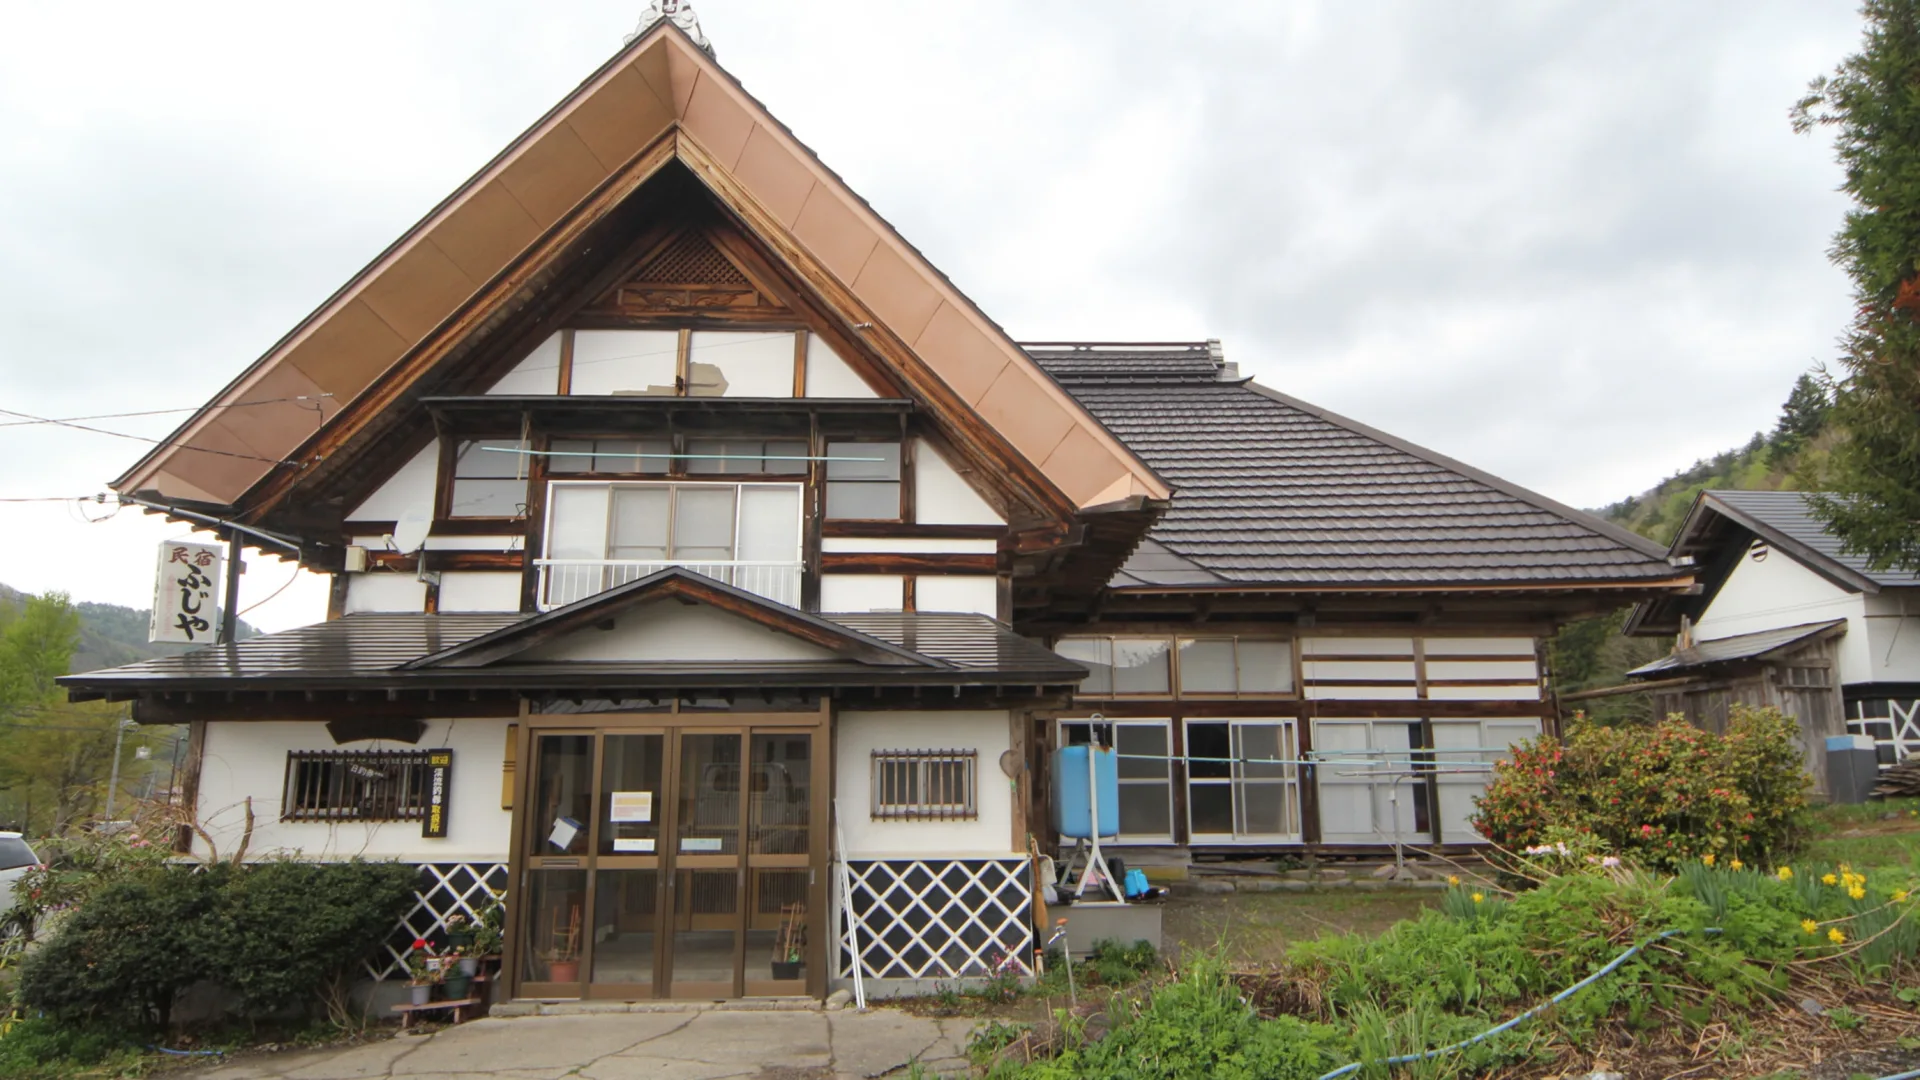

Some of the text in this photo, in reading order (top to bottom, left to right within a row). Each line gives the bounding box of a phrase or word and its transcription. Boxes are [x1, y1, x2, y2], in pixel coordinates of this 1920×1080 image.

[168, 547, 215, 566] 民宿
[173, 563, 211, 641] ふじや
